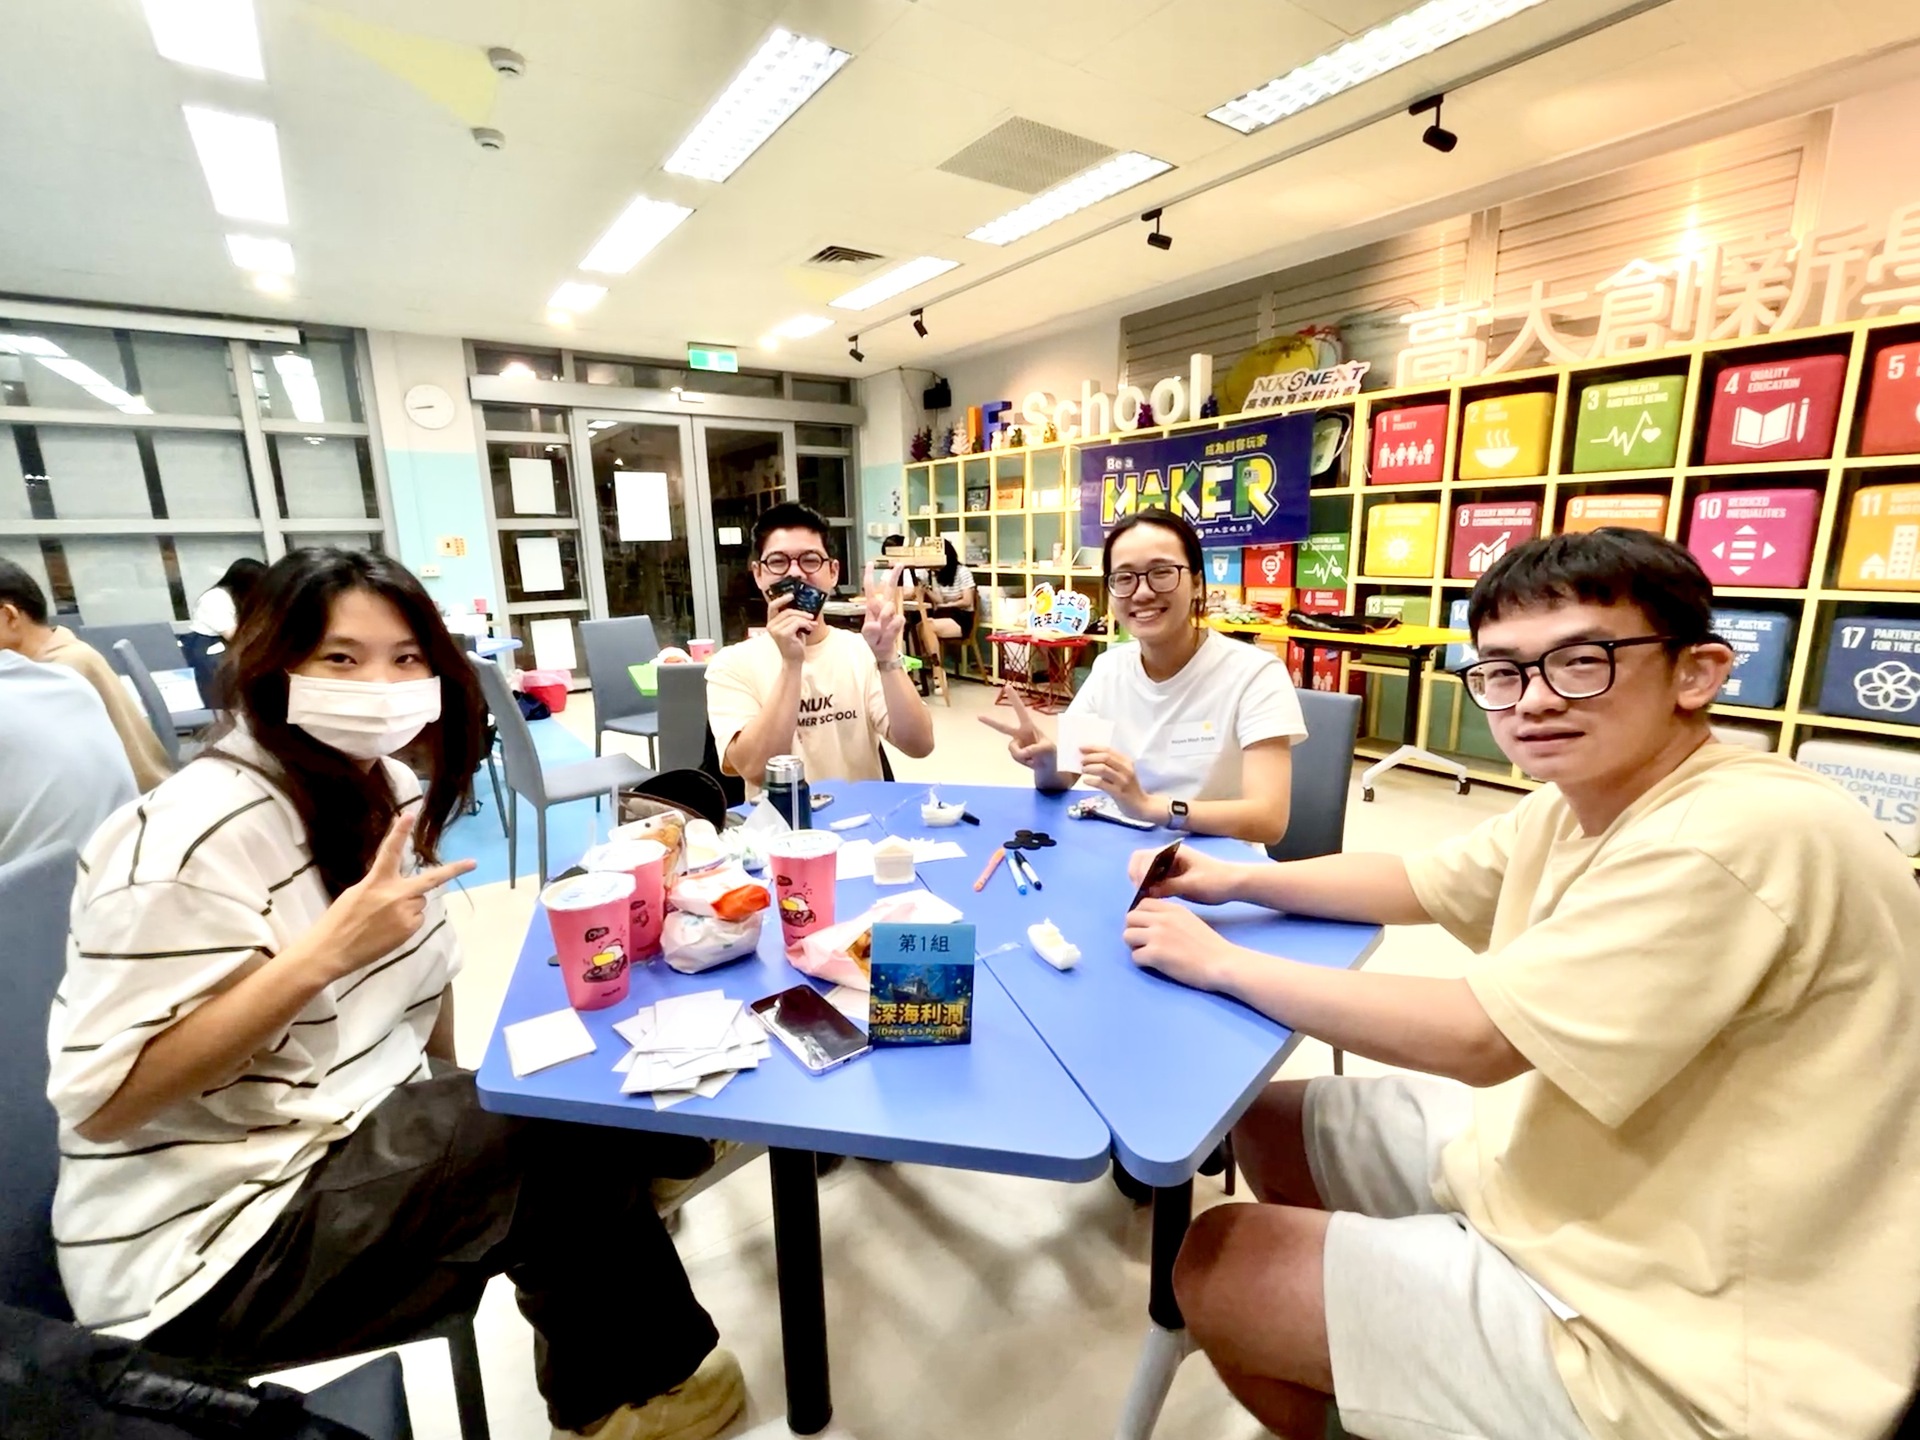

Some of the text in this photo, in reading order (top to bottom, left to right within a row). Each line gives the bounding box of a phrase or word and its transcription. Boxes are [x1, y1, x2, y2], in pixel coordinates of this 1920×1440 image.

[1396, 203, 1920, 388] 高大創新
[1750, 367, 1790, 381] QUALITY
[1887, 354, 1906, 380] 5
[1724, 373, 1740, 394] 4
[1747, 377, 1801, 393] EDUCATION
[1587, 389, 1600, 410] 3
[1381, 416, 1388, 432] 1
[1106, 456, 1122, 471] Be
[1101, 452, 1279, 527] MAKER
[1571, 499, 1584, 518] 9
[1699, 498, 1721, 519] 10
[1726, 508, 1786, 519] INEQUALITIES
[1861, 493, 1882, 517] 11
[1459, 509, 1470, 527] 8
[1304, 590, 1312, 605] 4
[1368, 598, 1380, 614] 13
[1453, 604, 1469, 621] 14
[1735, 620, 1773, 631] JUSTICE
[1841, 627, 1866, 648] 17
[1871, 640, 1892, 651] FOR
[1894, 641, 1912, 653] THE
[799, 694, 833, 713] NUK
[819, 710, 857, 725] SCOOL
[1859, 795, 1918, 825] LS
[899, 933, 950, 953] 第1組
[876, 1003, 964, 1025] 深海利潤
[907, 1027, 923, 1036] Sea
